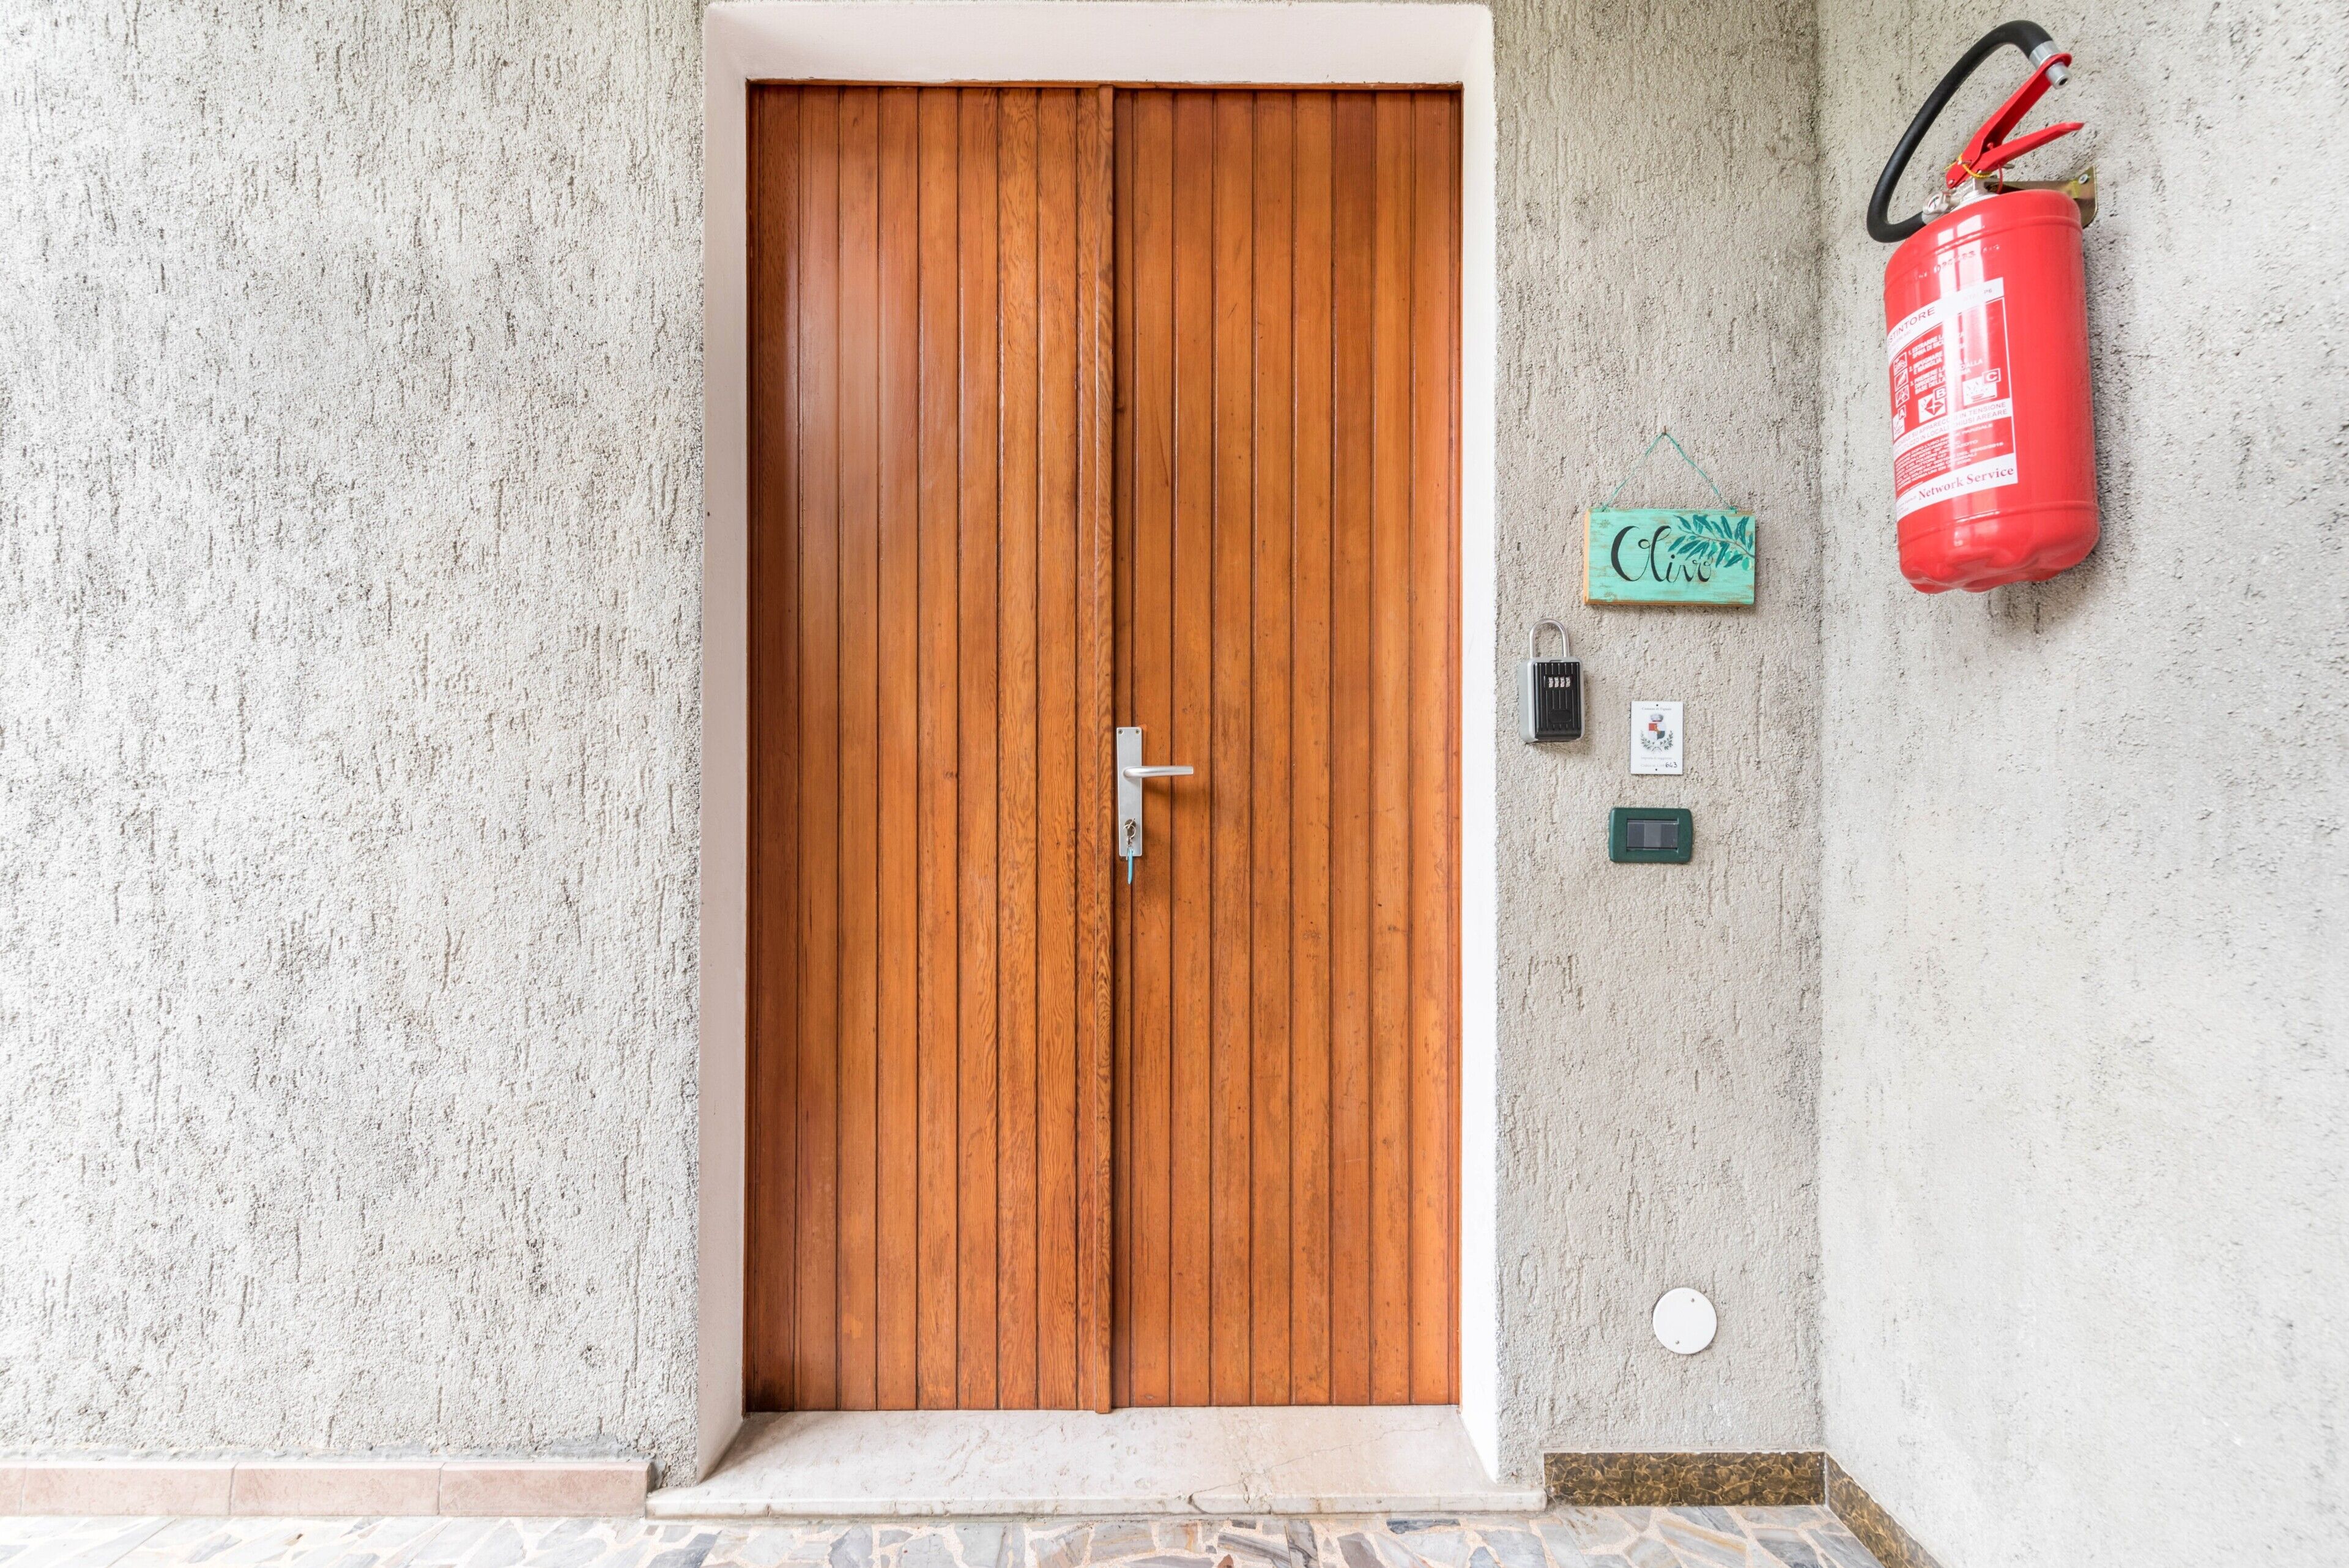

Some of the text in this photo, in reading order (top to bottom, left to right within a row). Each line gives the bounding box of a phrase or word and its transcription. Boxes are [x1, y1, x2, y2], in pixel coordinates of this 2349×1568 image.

[1887, 307, 1935, 344] STINTORE
[1986, 372, 1998, 382] C
[1936, 388, 1946, 398] B
[1969, 401, 2006, 415] TENSIONE
[1976, 409, 2008, 422] AREARE
[1918, 477, 1964, 500] Network
[1966, 467, 2014, 485] Service
[1611, 525, 1713, 583] Olivo
